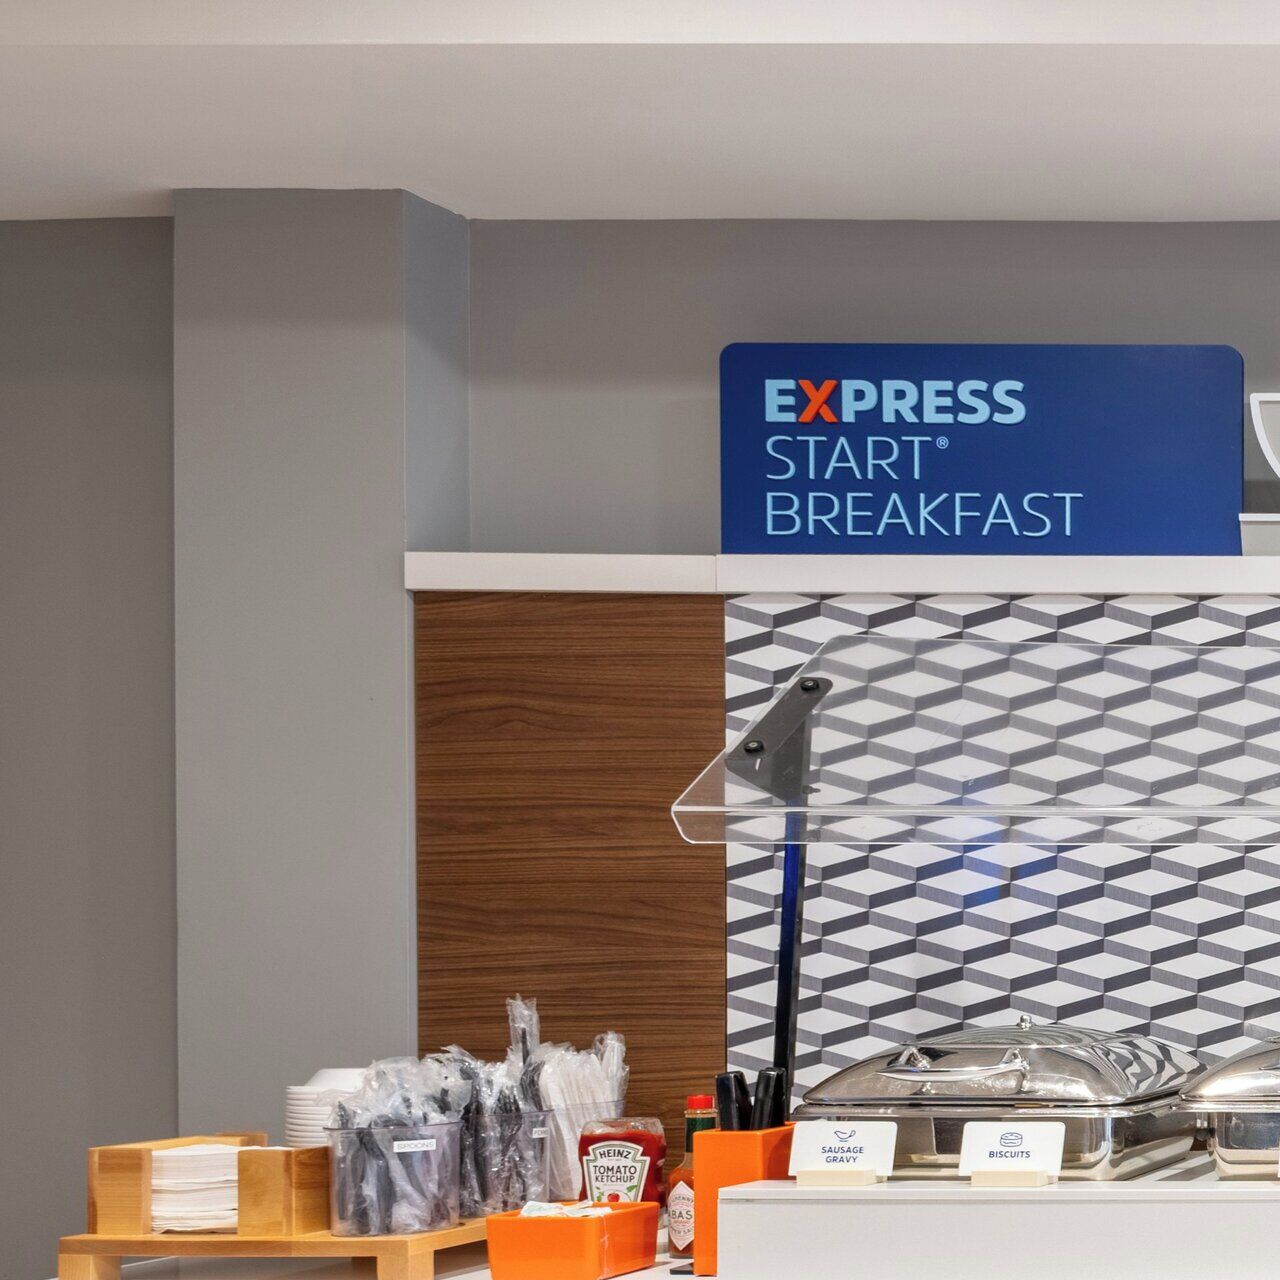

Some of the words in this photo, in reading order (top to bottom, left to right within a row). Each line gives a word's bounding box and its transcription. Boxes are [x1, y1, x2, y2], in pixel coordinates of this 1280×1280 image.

[764, 378, 1027, 425] EXPRESS
[765, 492, 1084, 537] BREAKFAST
[397, 1141, 434, 1151] SPOONS
[821, 1146, 864, 1154] SAUSAGE
[598, 1148, 632, 1160] HEINZ
[825, 1155, 858, 1163] GRAVY
[988, 1150, 1031, 1158] BISCUITS
[592, 1165, 638, 1175] TOMATO
[595, 1175, 635, 1183] KETCHUP
